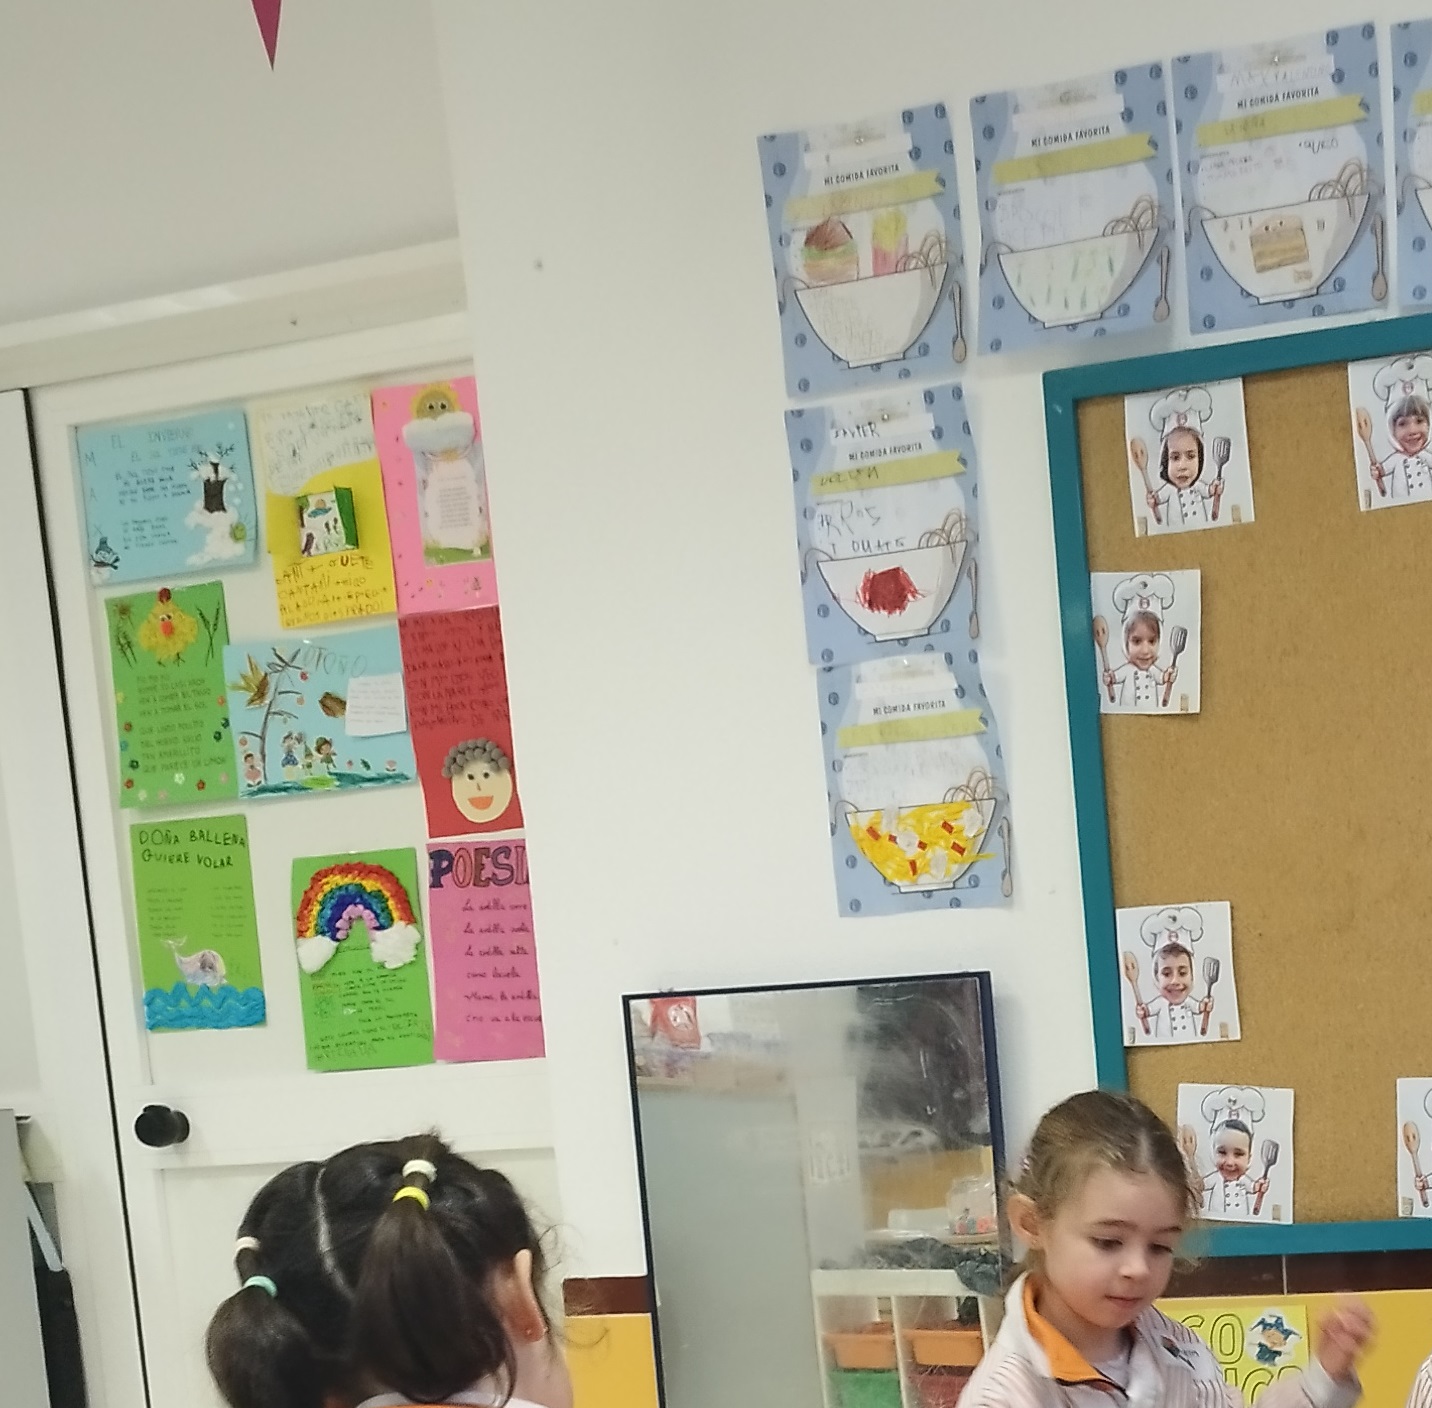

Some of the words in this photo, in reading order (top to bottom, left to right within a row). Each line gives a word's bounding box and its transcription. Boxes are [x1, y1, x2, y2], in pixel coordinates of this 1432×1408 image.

[1237, 99, 1248, 110] MI
[1250, 93, 1281, 108] COMIDA
[1282, 86, 1320, 103] FAVORITA
[1031, 138, 1042, 149] MI
[1043, 132, 1074, 148] COMIDA
[1075, 125, 1112, 142] FAVORITA
[824, 176, 834, 187] MI
[836, 170, 865, 185] COMIDA
[866, 163, 900, 179] FAVORITA
[849, 452, 859, 462] MI
[860, 447, 888, 461] COMIDA
[889, 442, 923, 456] FAVORITA
[873, 706, 882, 716] MI
[884, 702, 912, 715] COMIDA
[913, 699, 946, 712] FAVORITA
[138, 829, 180, 846] DOÑA
[189, 829, 246, 848] BALLENA
[197, 853, 234, 869] VOLAR
[428, 846, 530, 889] POESI
